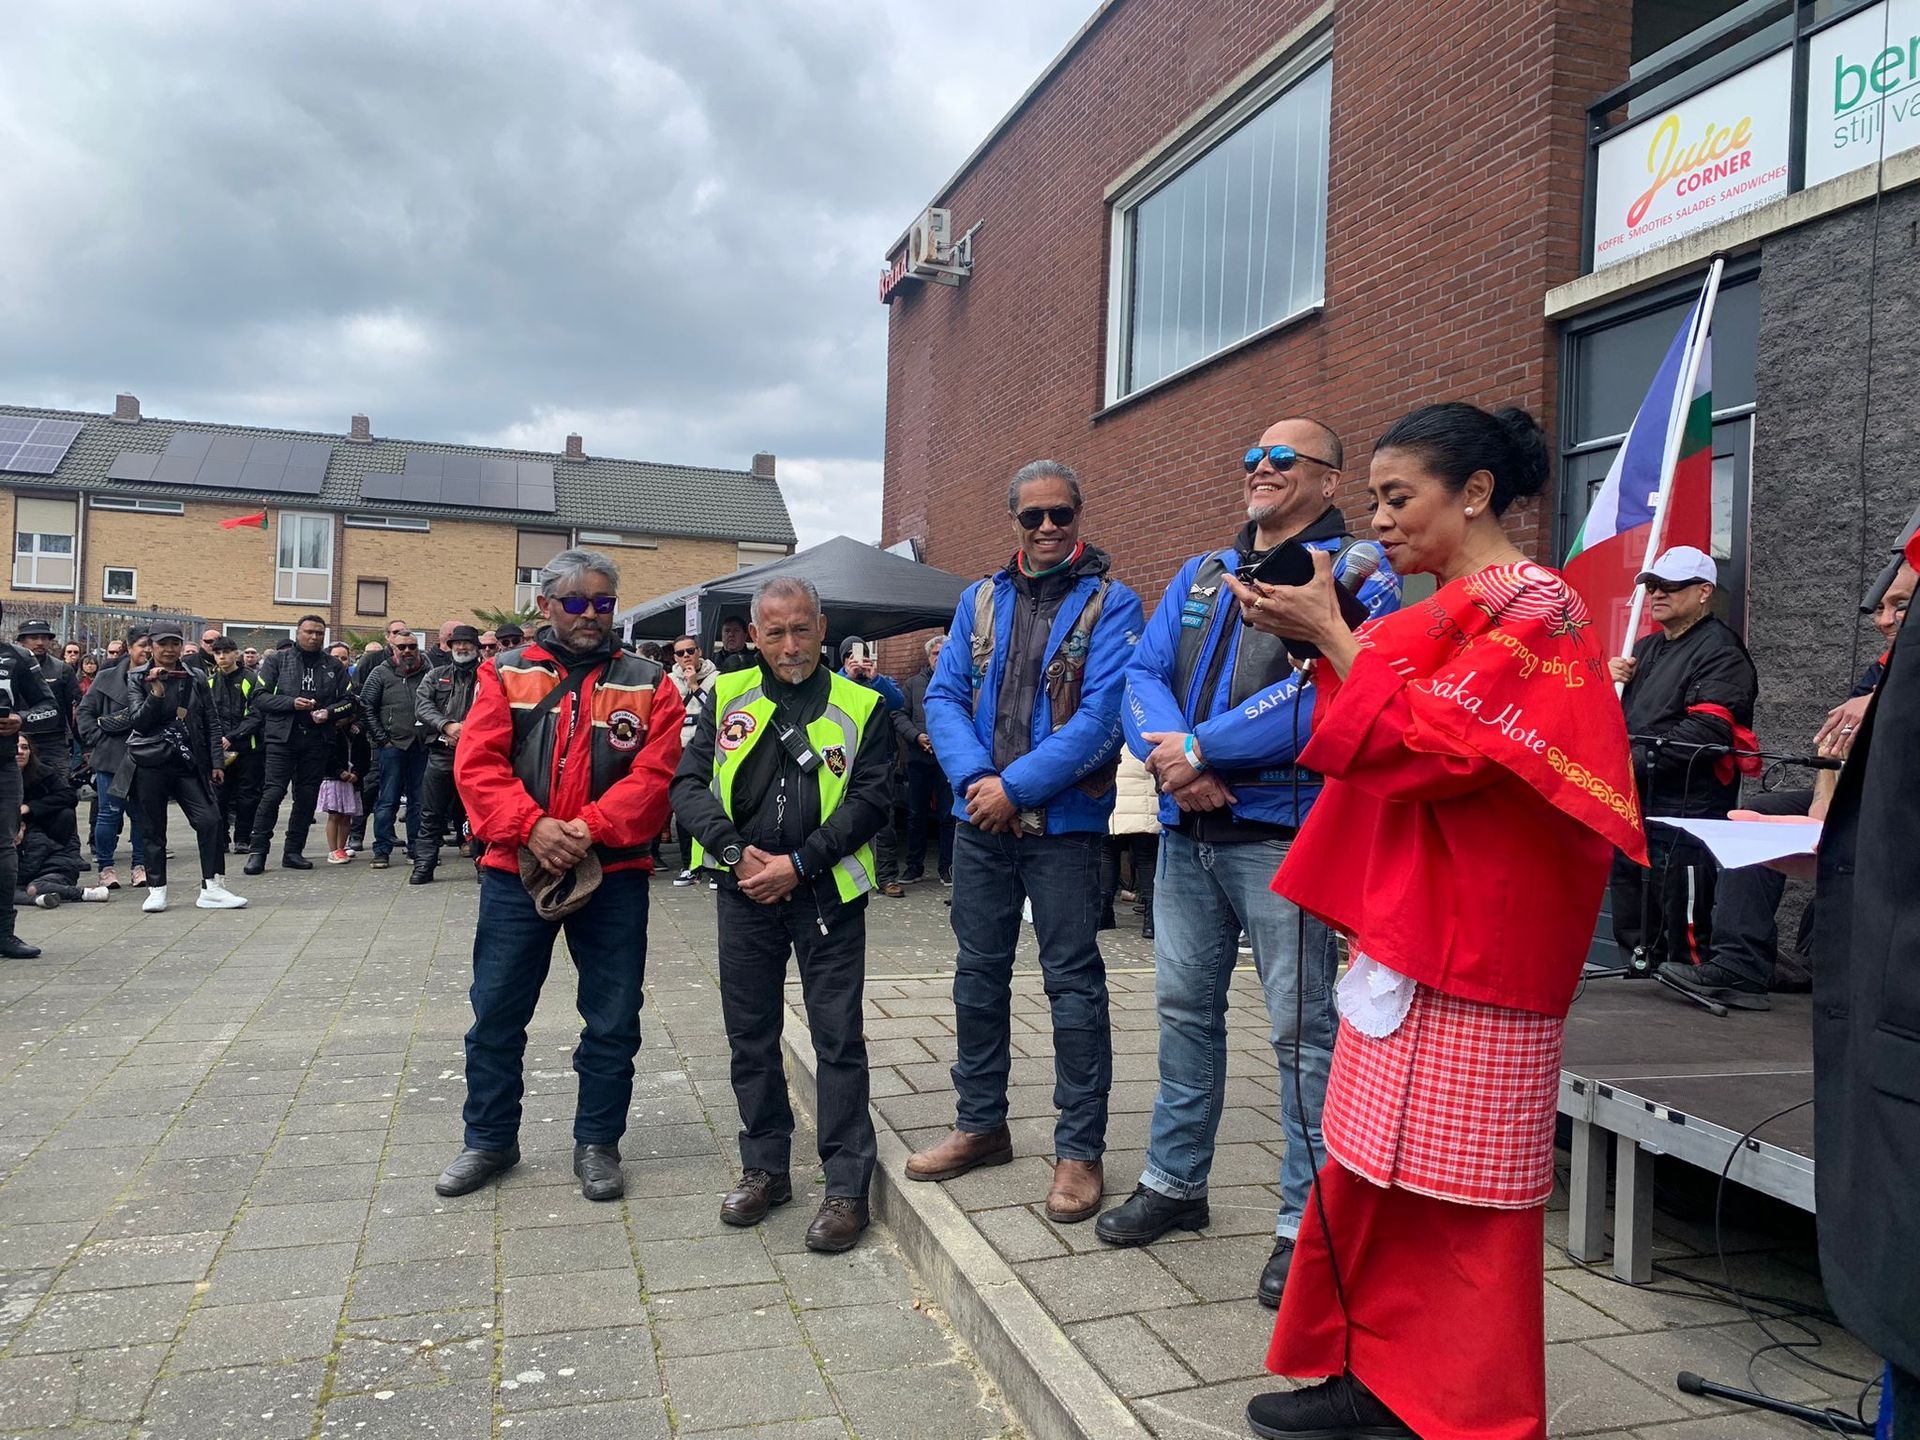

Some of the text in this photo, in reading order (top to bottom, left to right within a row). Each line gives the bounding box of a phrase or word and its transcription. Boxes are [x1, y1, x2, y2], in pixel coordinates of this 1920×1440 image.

[1833, 103, 1880, 149] stijl
[1627, 114, 1753, 228] Juice
[1676, 150, 1752, 197] CORNER
[1597, 165, 1787, 253] KOFFIE SMOOTIES SALADES SANDWICHES
[1244, 680, 1312, 720] SAHA
[1478, 703, 1547, 755] Hote
